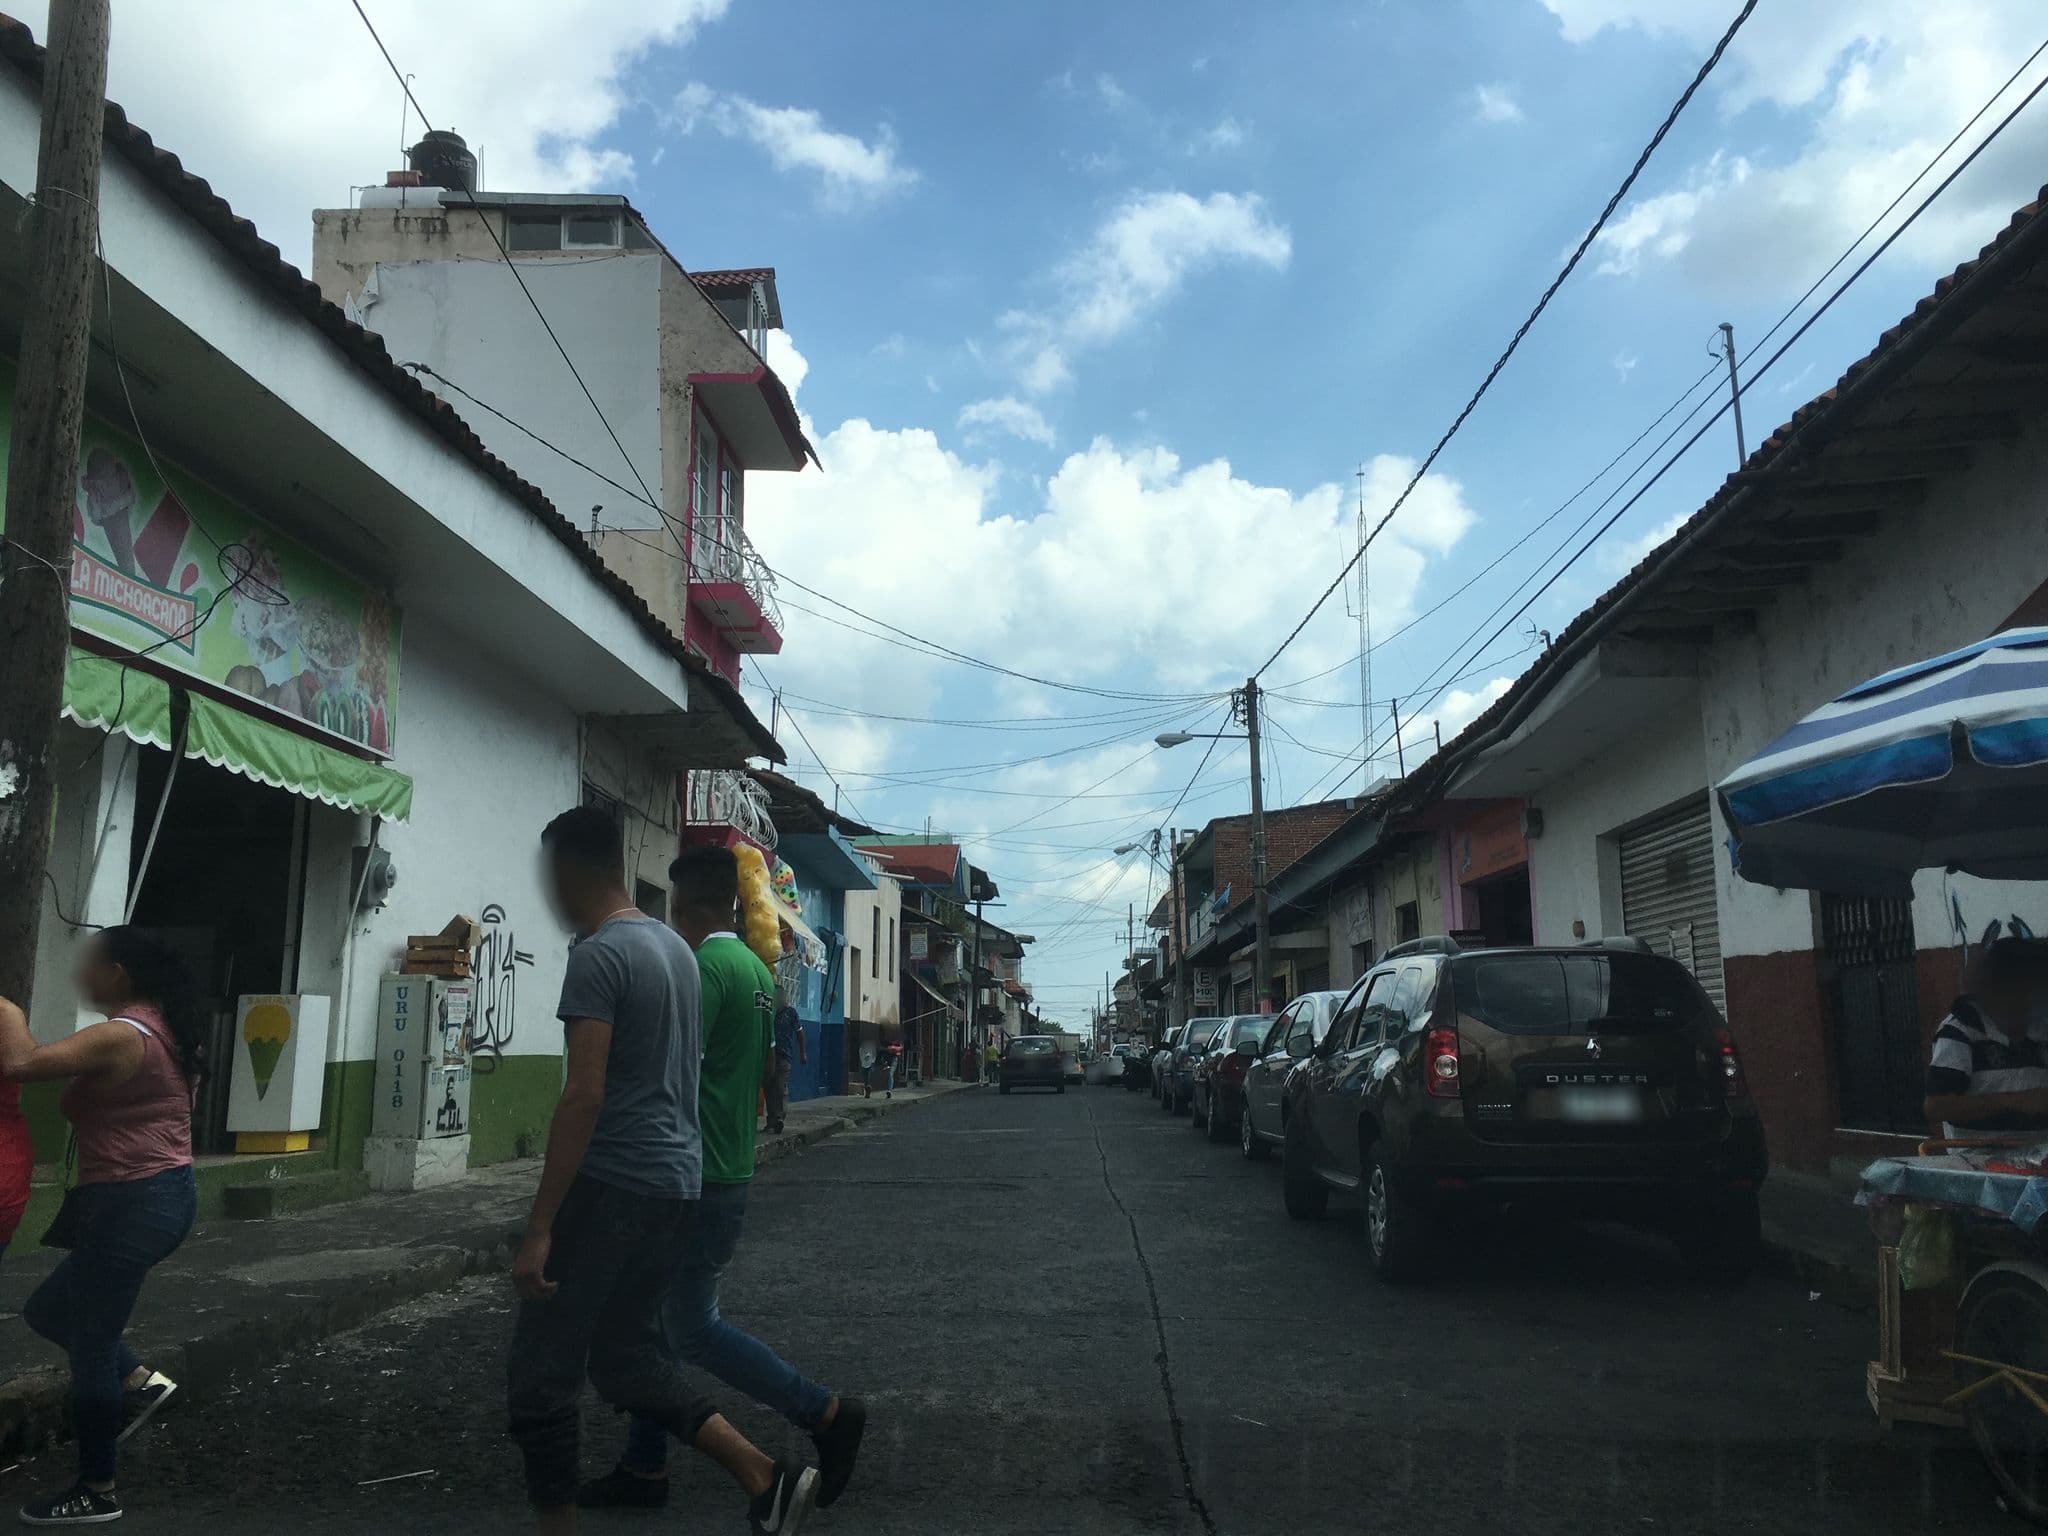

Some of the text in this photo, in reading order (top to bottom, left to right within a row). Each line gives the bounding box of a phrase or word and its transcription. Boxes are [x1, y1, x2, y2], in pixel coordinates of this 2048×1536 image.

[71, 551, 187, 637] LA MICHOACANA
[1200, 972, 1210, 984] E
[391, 986, 409, 1109] URU 0118
[1546, 1074, 1648, 1084] DUSTER
